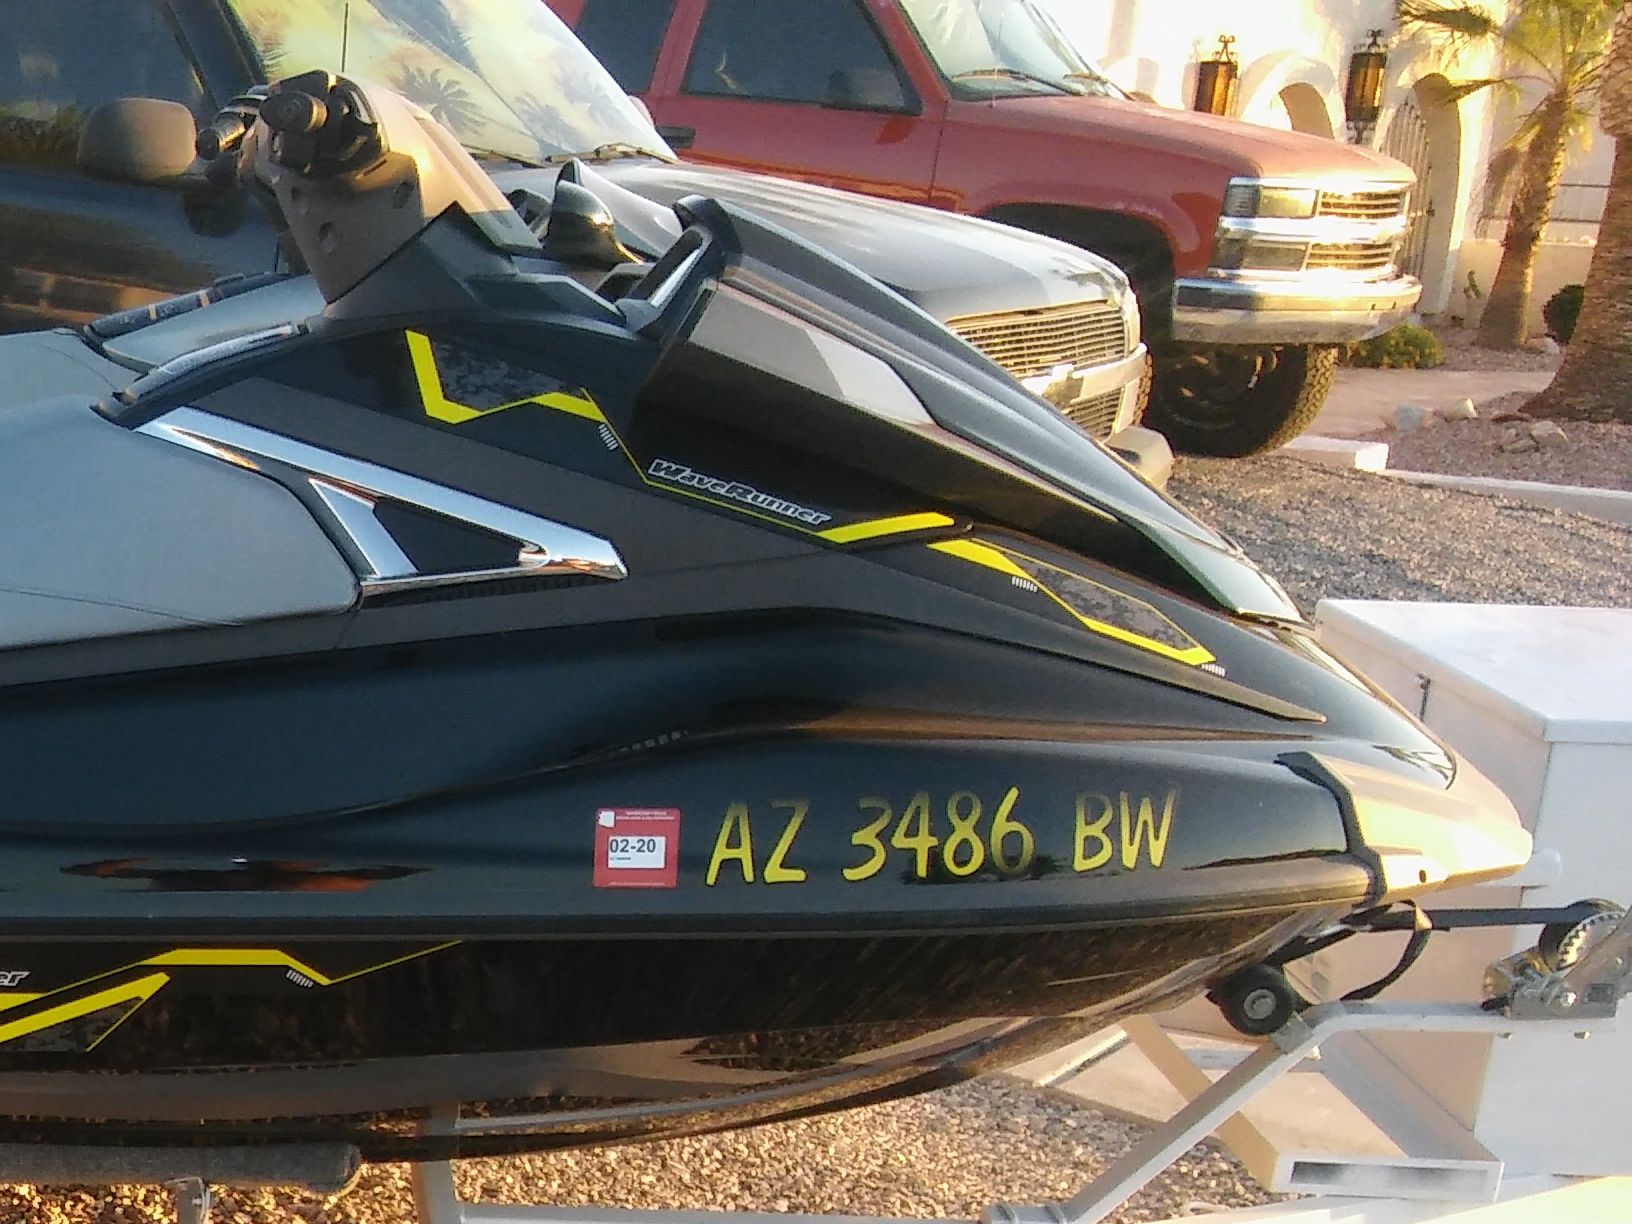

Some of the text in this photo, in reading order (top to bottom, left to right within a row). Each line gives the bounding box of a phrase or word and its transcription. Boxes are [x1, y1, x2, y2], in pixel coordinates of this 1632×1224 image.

[648, 458, 832, 526] WaveRunner
[610, 838, 656, 854] 02-20
[704, 785, 1178, 886] AZ 3486 BW
